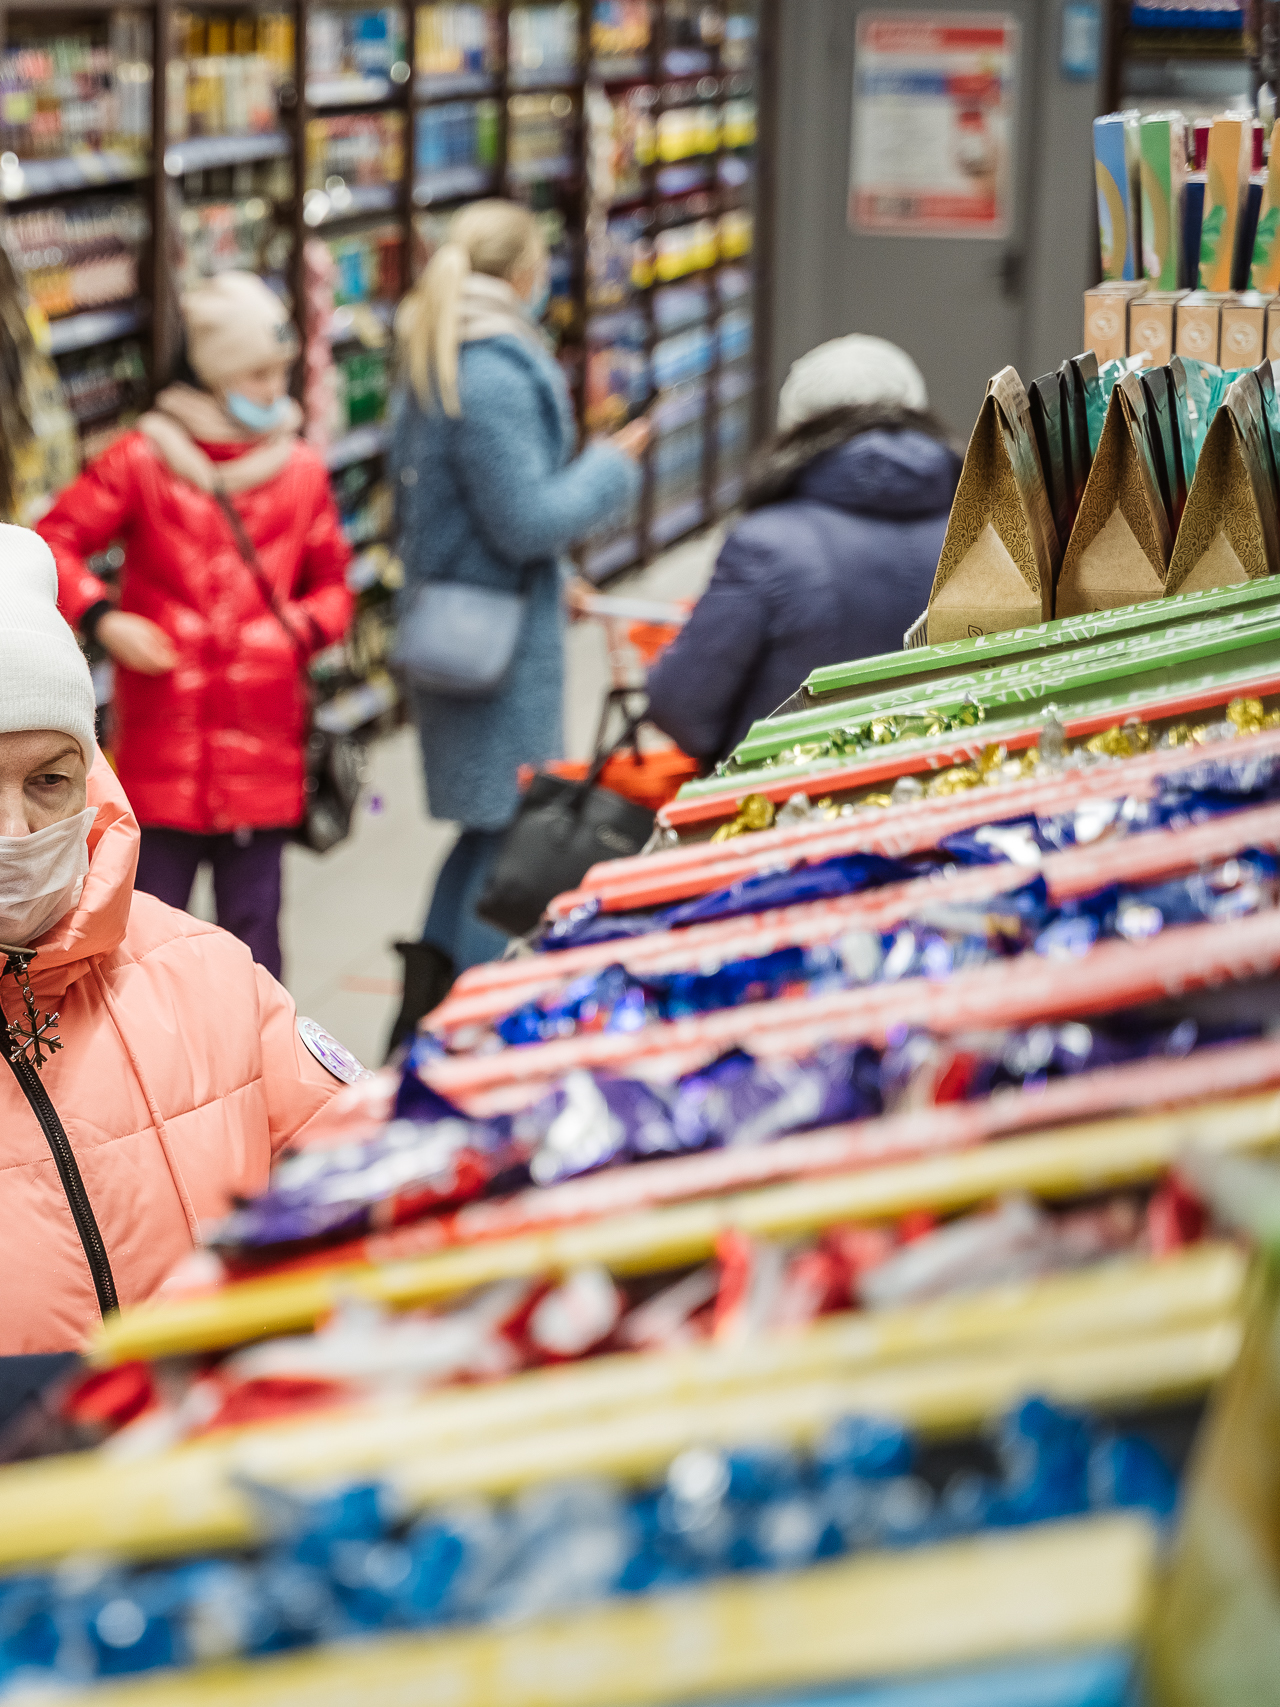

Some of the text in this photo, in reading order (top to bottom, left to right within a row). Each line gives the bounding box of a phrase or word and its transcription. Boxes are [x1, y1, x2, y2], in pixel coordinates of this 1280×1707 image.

[974, 576, 1276, 647] КАТЕГОРИЯ №1
[925, 613, 1244, 694] КАТЕГОРИЯ №1
